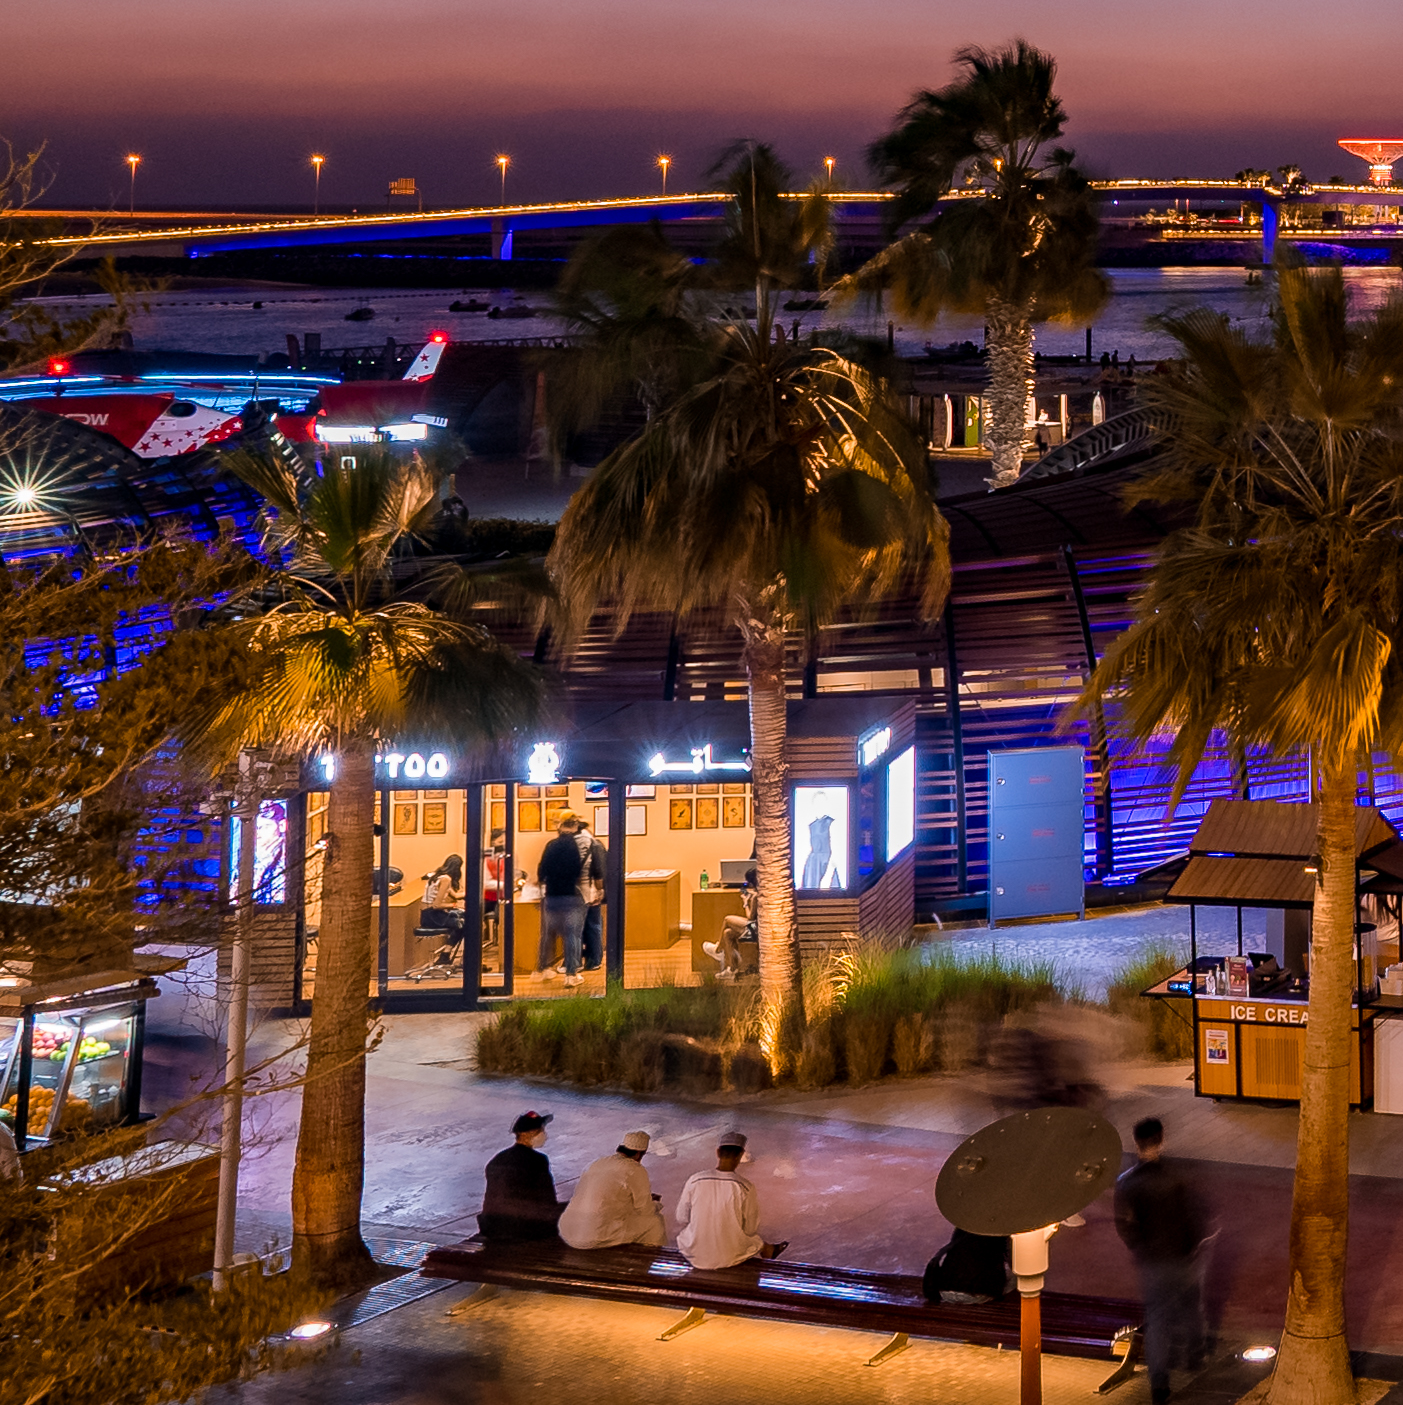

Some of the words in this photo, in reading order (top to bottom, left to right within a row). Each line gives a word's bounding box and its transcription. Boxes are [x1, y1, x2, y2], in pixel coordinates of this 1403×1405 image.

[320, 752, 448, 781] TTOO
[1230, 1005, 1257, 1021] ICE
[1264, 1007, 1309, 1025] CREA
